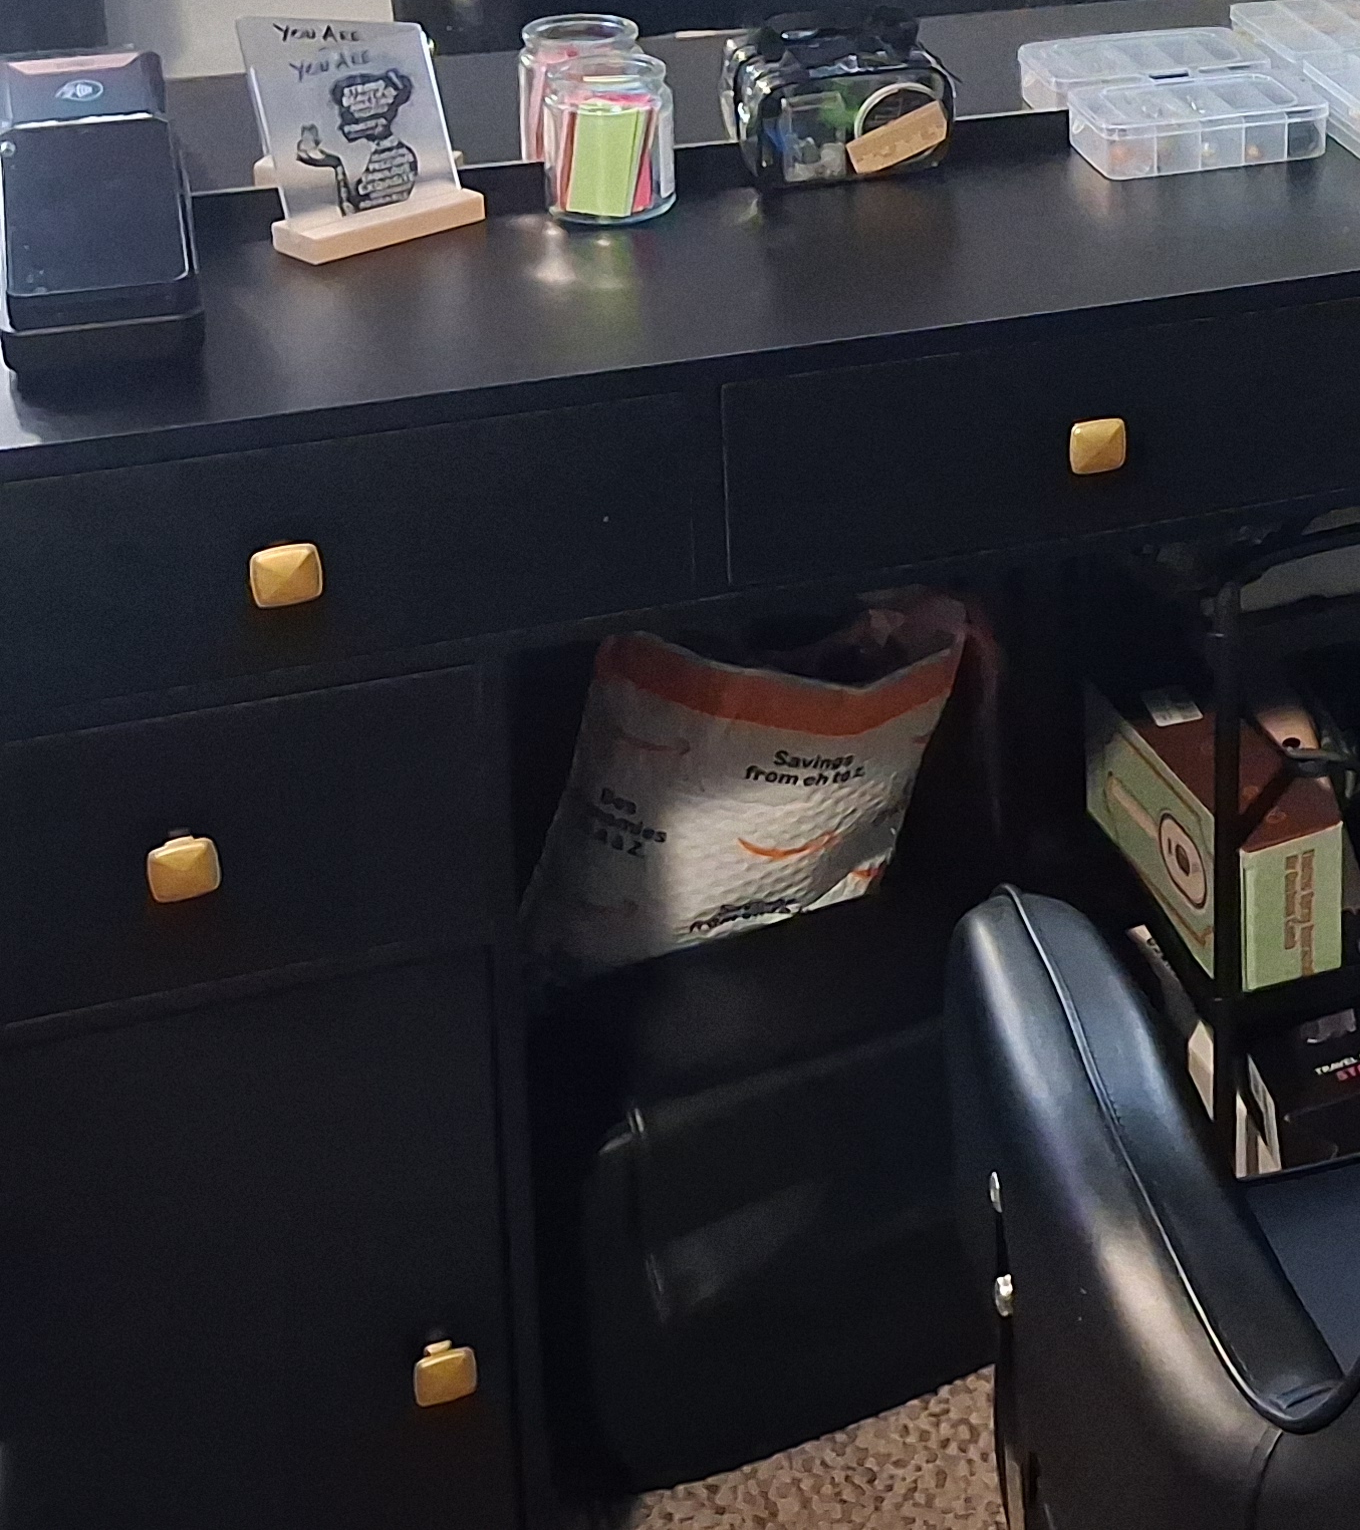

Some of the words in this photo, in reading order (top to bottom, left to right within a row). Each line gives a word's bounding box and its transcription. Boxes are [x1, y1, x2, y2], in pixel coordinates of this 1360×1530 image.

[773, 749, 855, 771] Savings
[744, 764, 800, 786] from
[832, 769, 852, 784] to
